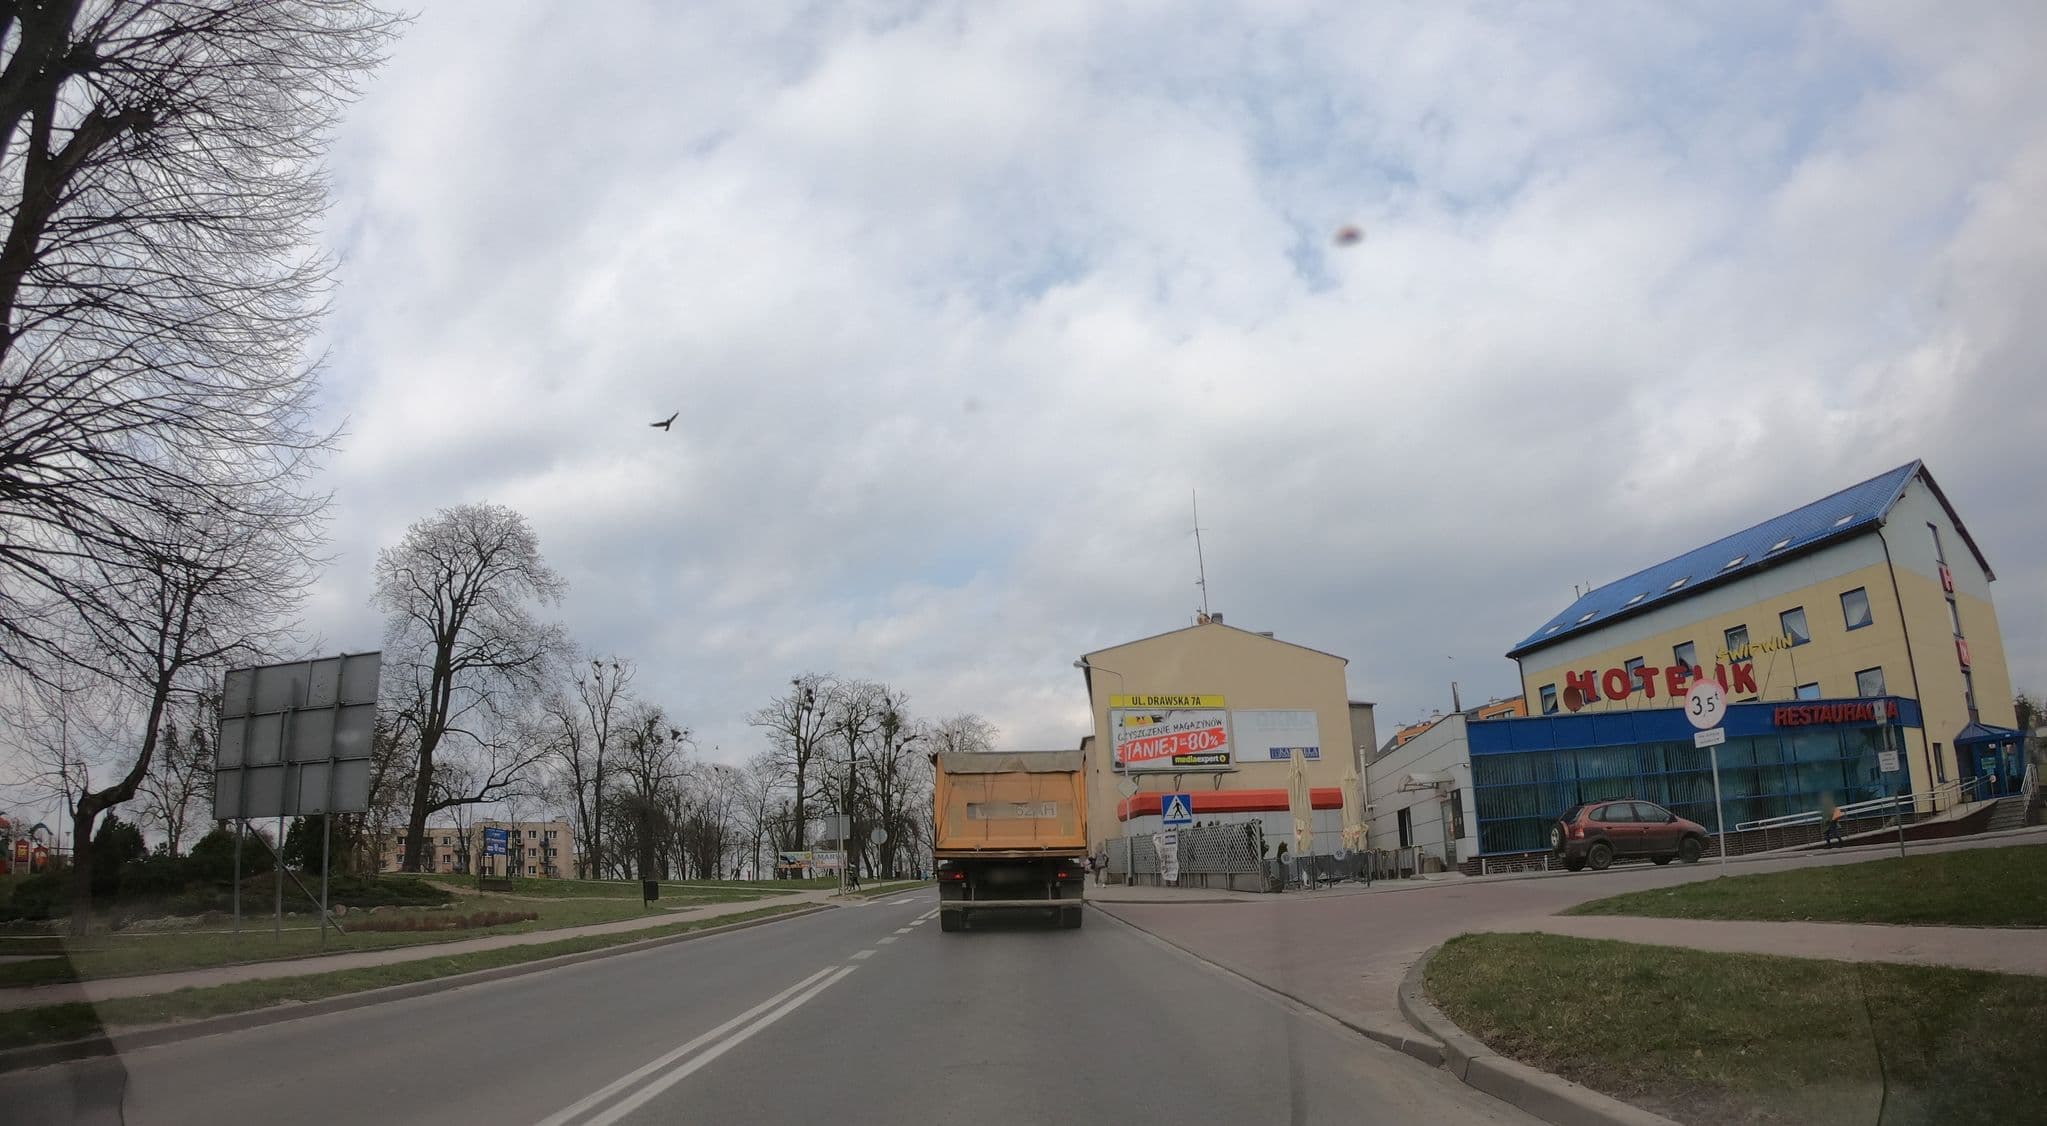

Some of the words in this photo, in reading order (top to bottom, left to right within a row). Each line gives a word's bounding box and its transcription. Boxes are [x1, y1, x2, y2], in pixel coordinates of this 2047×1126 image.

[1131, 696, 1145, 706] UL.
[1147, 696, 1190, 706] DRAWSKA
[1191, 696, 1201, 706] 7A
[1774, 702, 1898, 726] RESTAURACA
[1173, 717, 1222, 732] MAGAZYNÓW
[1126, 736, 1178, 759] TANIEJ
